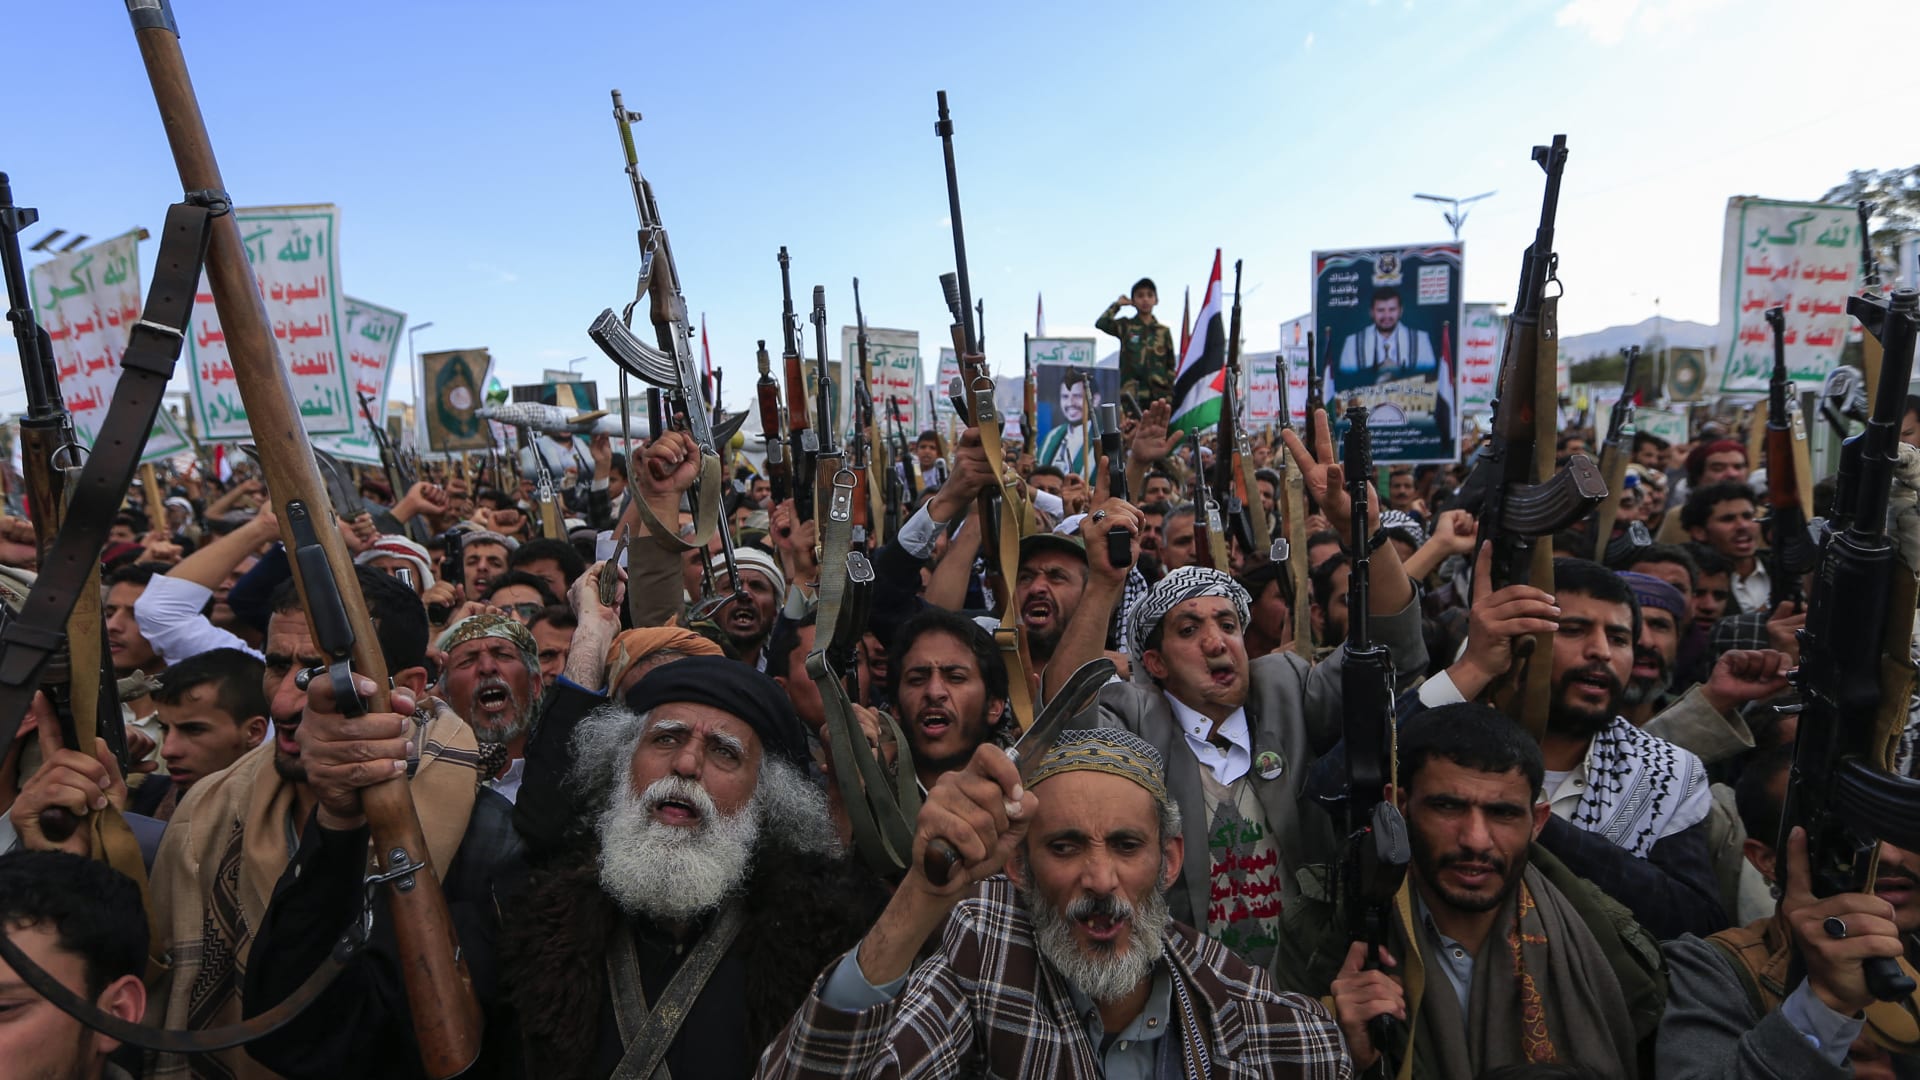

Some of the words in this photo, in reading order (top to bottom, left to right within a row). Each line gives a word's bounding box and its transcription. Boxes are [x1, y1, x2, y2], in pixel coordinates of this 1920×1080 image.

[278, 227, 324, 262] الله
[1816, 217, 1862, 247] الله
[270, 276, 327, 306] الموت
[274, 313, 331, 345] الموت
